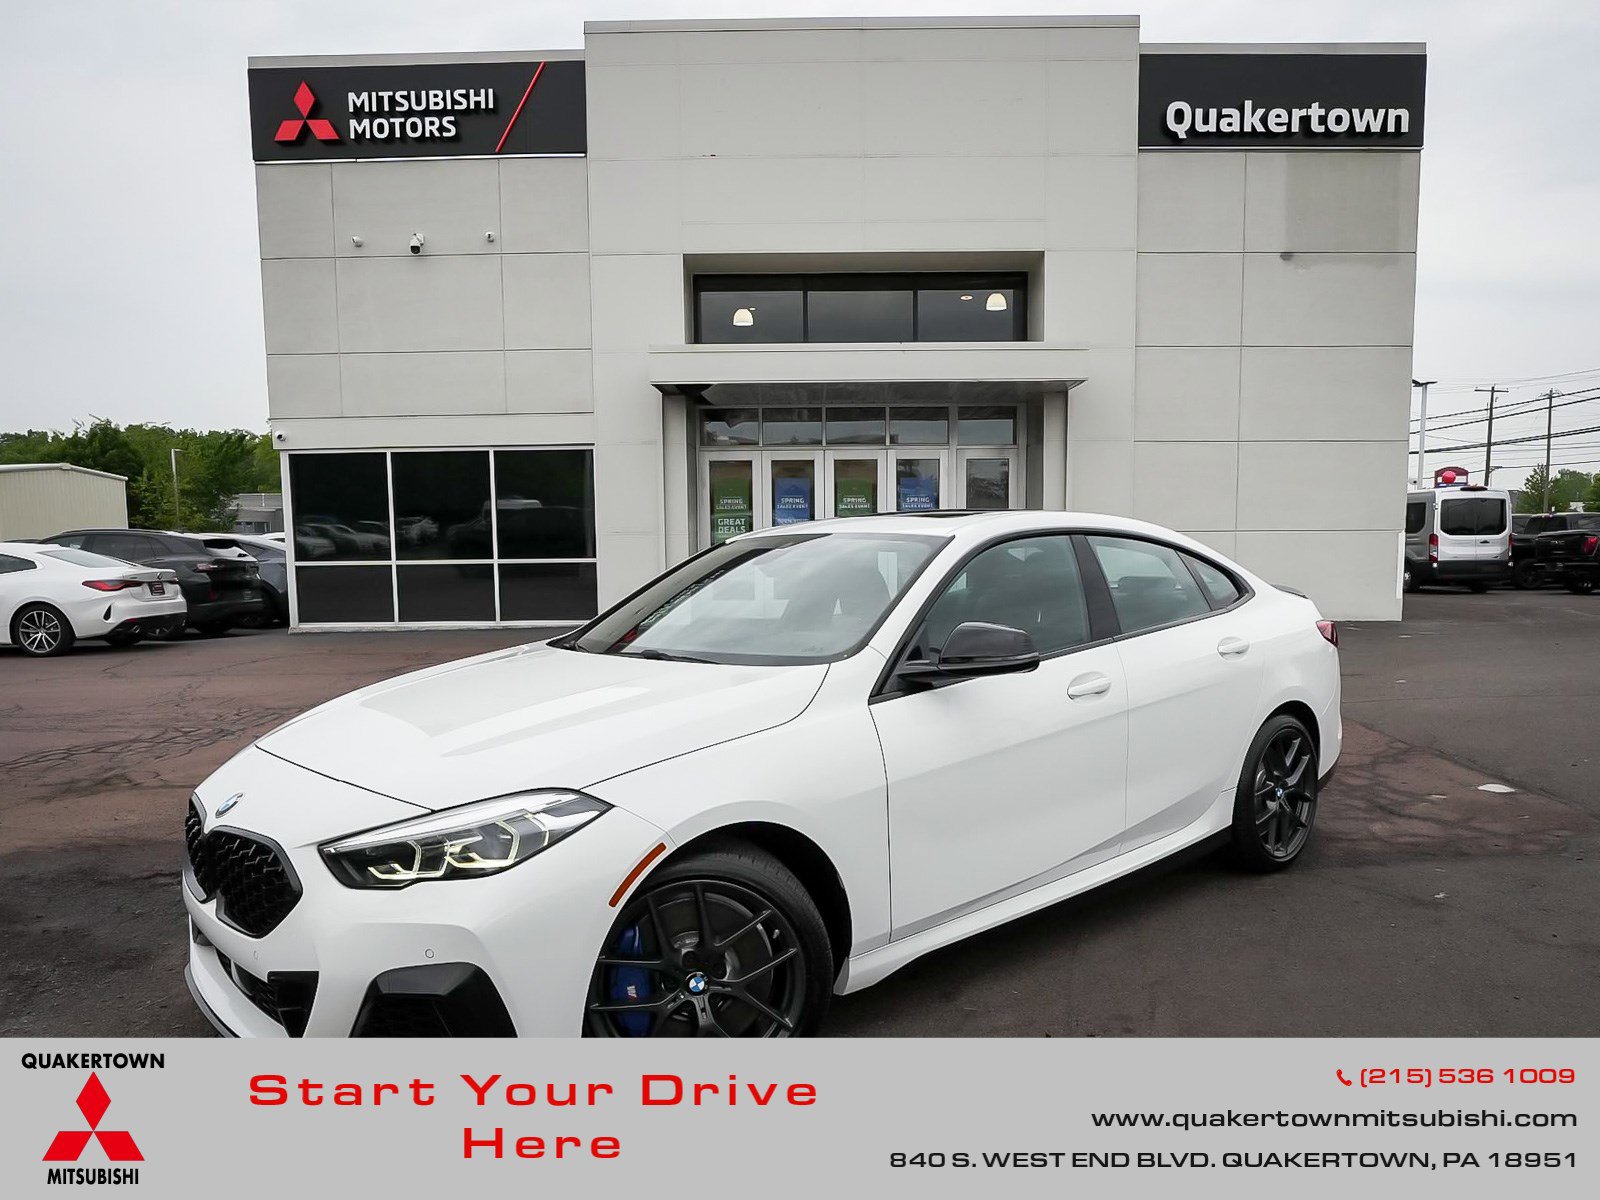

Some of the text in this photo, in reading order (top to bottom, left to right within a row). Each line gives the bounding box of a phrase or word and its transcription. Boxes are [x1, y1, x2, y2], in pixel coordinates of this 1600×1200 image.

[348, 88, 494, 112] MITSUBISHI
[349, 116, 457, 139] MOTORS
[1166, 100, 1410, 139] Quakertown
[717, 518, 746, 526] GREAT
[718, 526, 746, 534] DEALS
